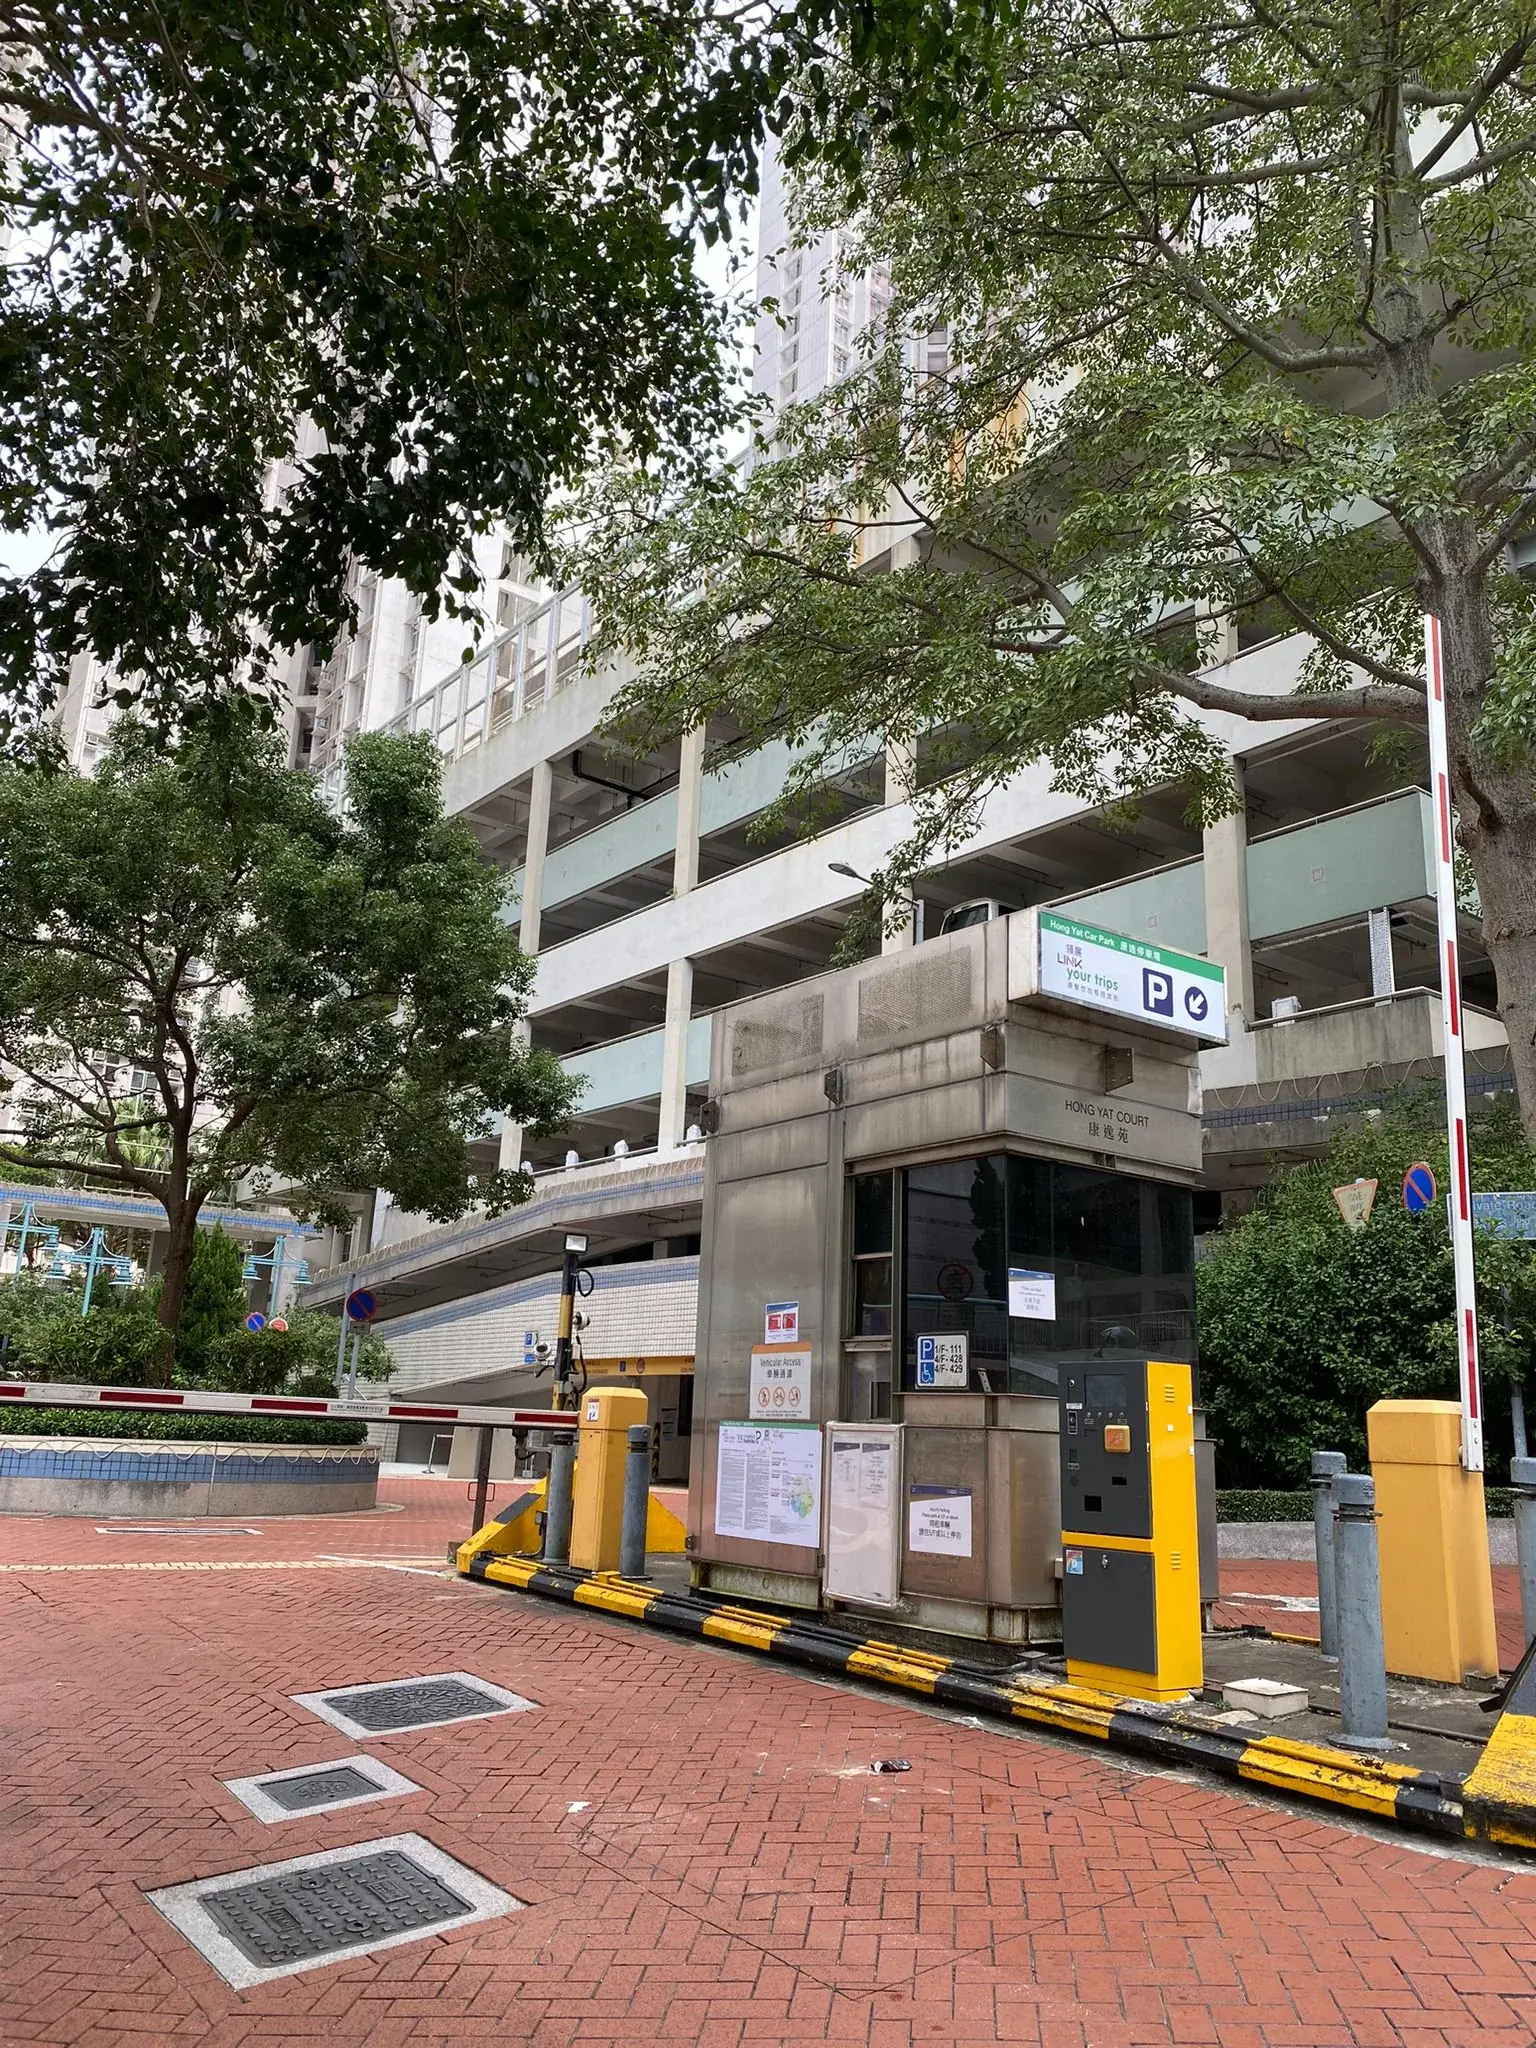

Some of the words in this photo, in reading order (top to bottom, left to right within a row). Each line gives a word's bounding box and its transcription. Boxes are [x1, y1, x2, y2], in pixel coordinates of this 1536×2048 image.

[1050, 920, 1070, 934] Hong
[1070, 927, 1084, 938] Yat
[1084, 930, 1099, 942] Car
[1099, 935, 1115, 947] Park
[1057, 952, 1083, 969] LINK
[1067, 967, 1092, 984] your
[1095, 973, 1119, 991] trips
[1065, 1100, 1095, 1115] HONG
[1097, 1107, 1114, 1119] YAT
[1116, 1110, 1149, 1127] COURT
[1088, 1122, 1129, 1143] 康逸苑
[922, 1340, 933, 1359] P
